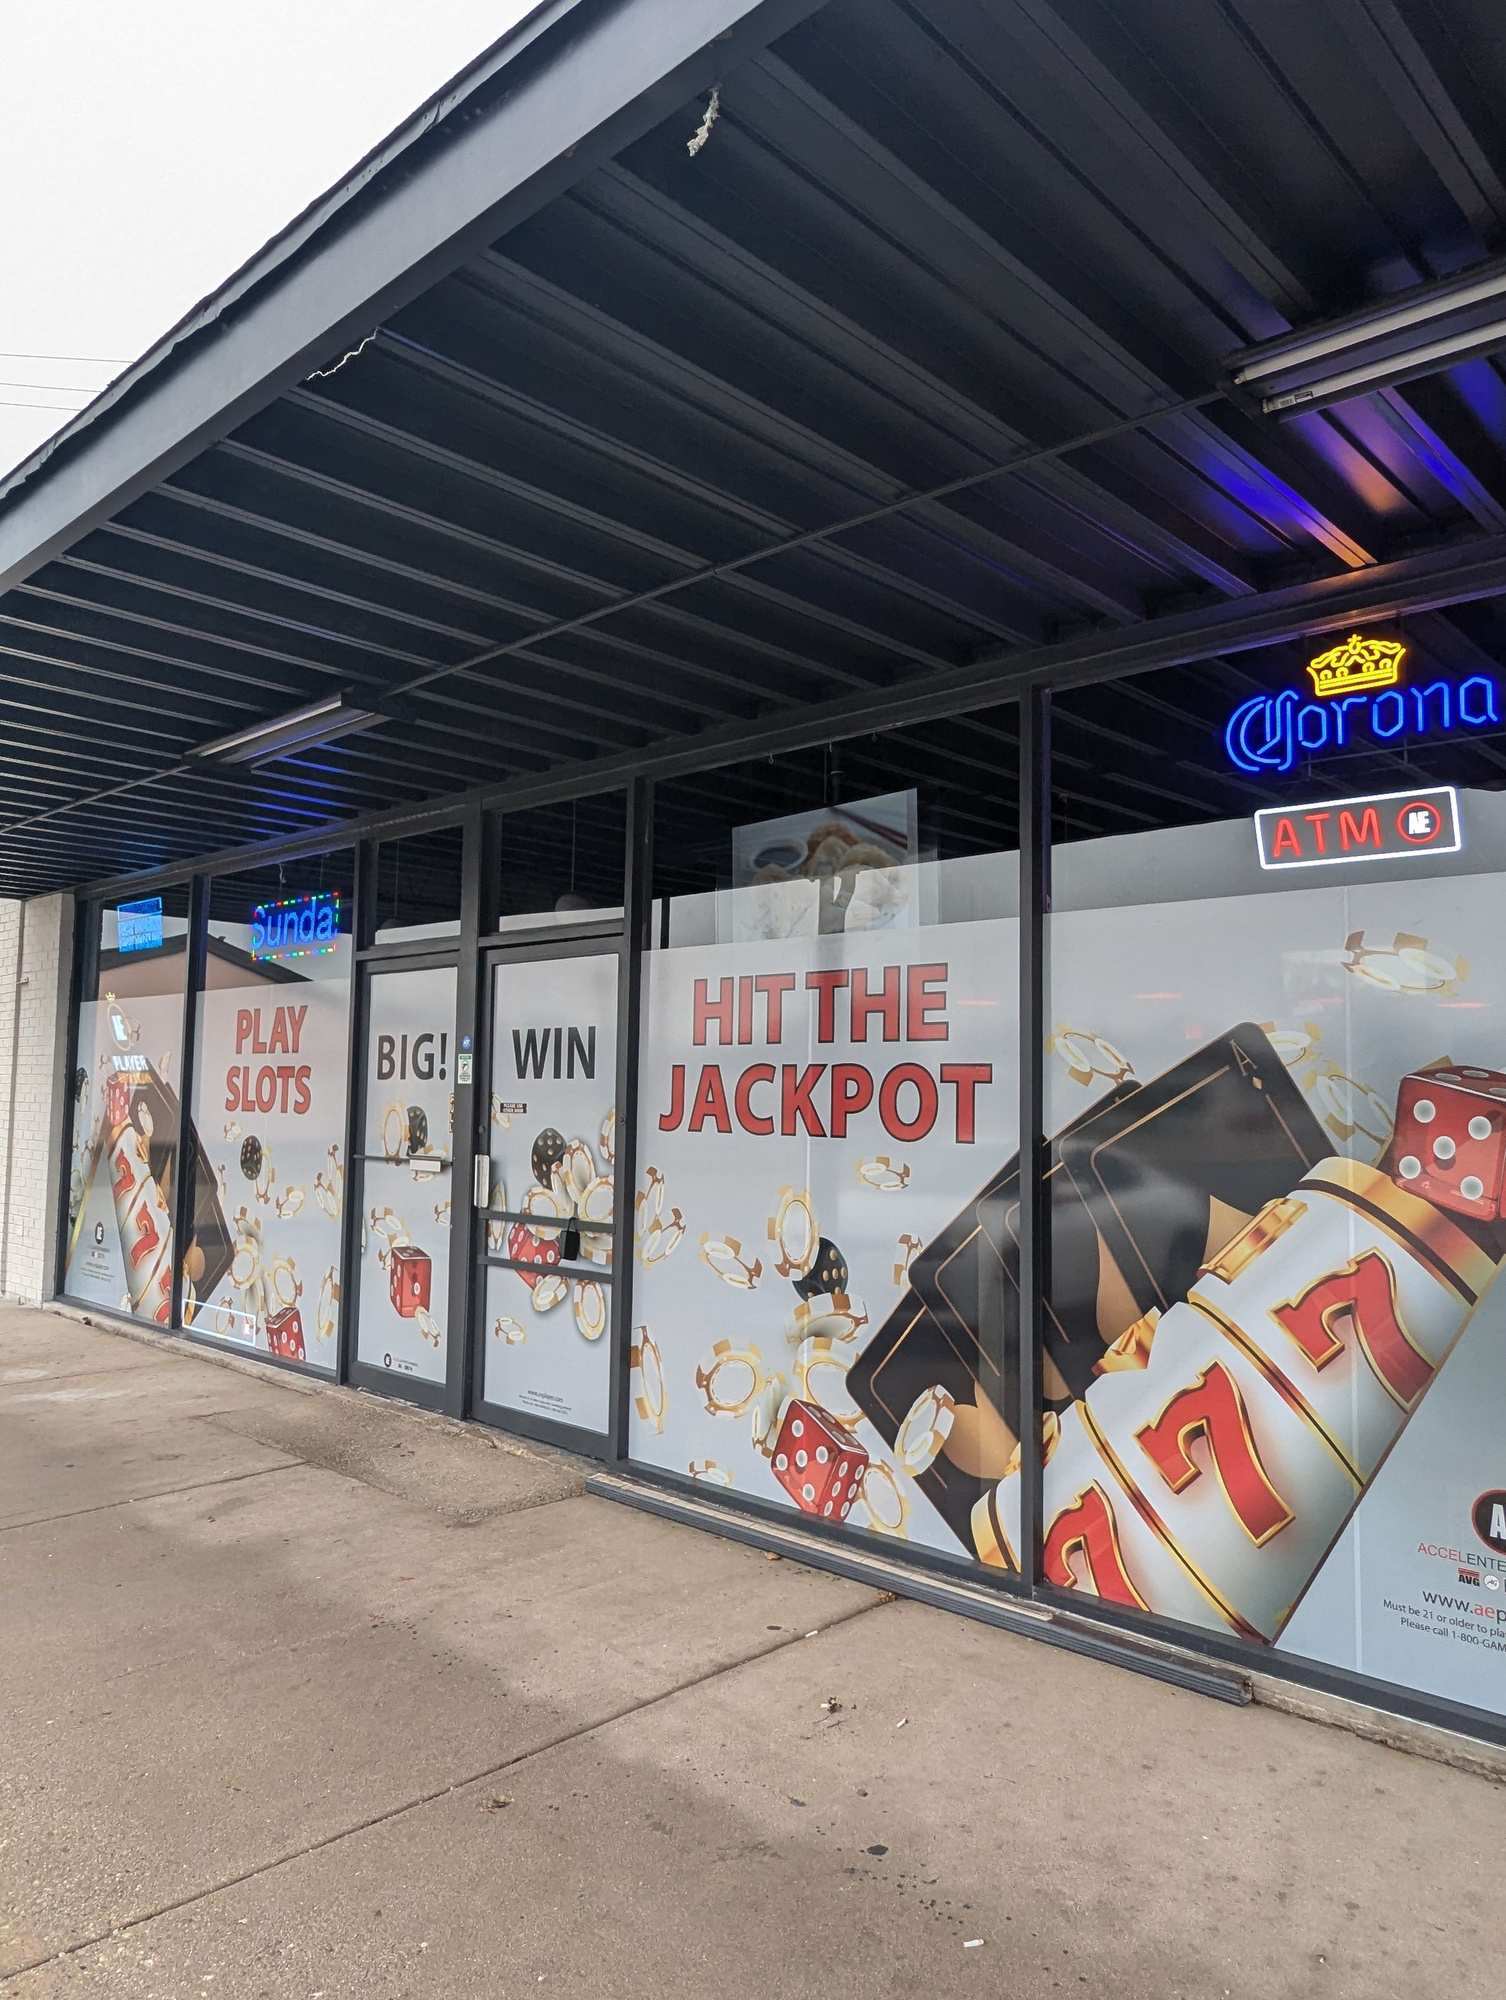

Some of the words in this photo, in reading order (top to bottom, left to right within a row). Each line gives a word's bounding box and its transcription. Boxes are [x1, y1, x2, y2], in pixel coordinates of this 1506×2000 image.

[1226, 676, 1498, 771] Corona
[1271, 807, 1383, 859] ATM
[692, 973, 796, 1046] HIT
[805, 962, 950, 1044] THE
[235, 1005, 308, 1055] PLAY
[512, 1026, 596, 1080] WIN
[376, 1032, 448, 1081] BIG!
[224, 1064, 312, 1115] SLOTS
[658, 1062, 993, 1145] JACKPOT
[1268, 1246, 1438, 1416] 7
[1132, 1358, 1297, 1550] 7
[1457, 1574, 1480, 1587] AVG
[1383, 1599, 1407, 1614] Must
[1408, 1605, 1421, 1616] be
[1422, 1609, 1434, 1620] 21
[1436, 1614, 1447, 1624] or
[1449, 1617, 1475, 1632] older
[1477, 1623, 1488, 1635] to
[1489, 1627, 1506, 1639] pla
[1400, 1617, 1431, 1633] Please
[1432, 1626, 1449, 1637] call
[1422, 1591, 1506, 1625] www.aep
